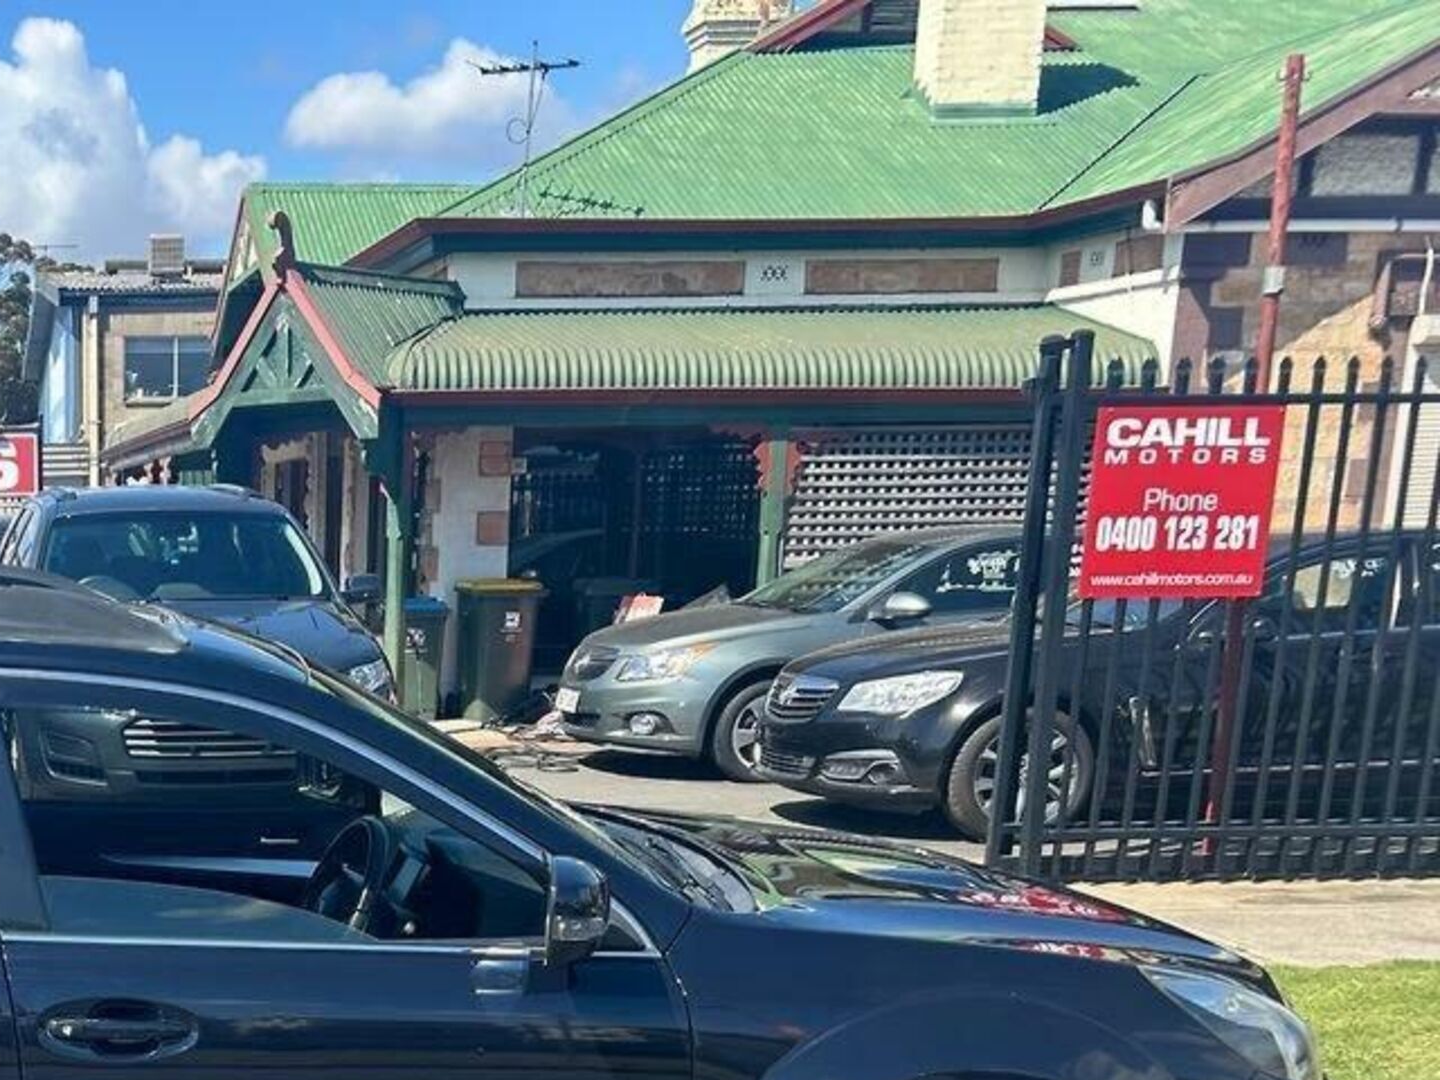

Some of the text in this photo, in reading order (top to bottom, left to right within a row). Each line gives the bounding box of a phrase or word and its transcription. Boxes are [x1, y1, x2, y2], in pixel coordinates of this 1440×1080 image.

[1107, 417, 1270, 446] CAHILL
[1104, 447, 1267, 464] MOTORS
[1143, 487, 1217, 511] Phone
[1095, 515, 1258, 551] 0400 123 281
[1091, 572, 1252, 586] www.cahillmotors.com.au
